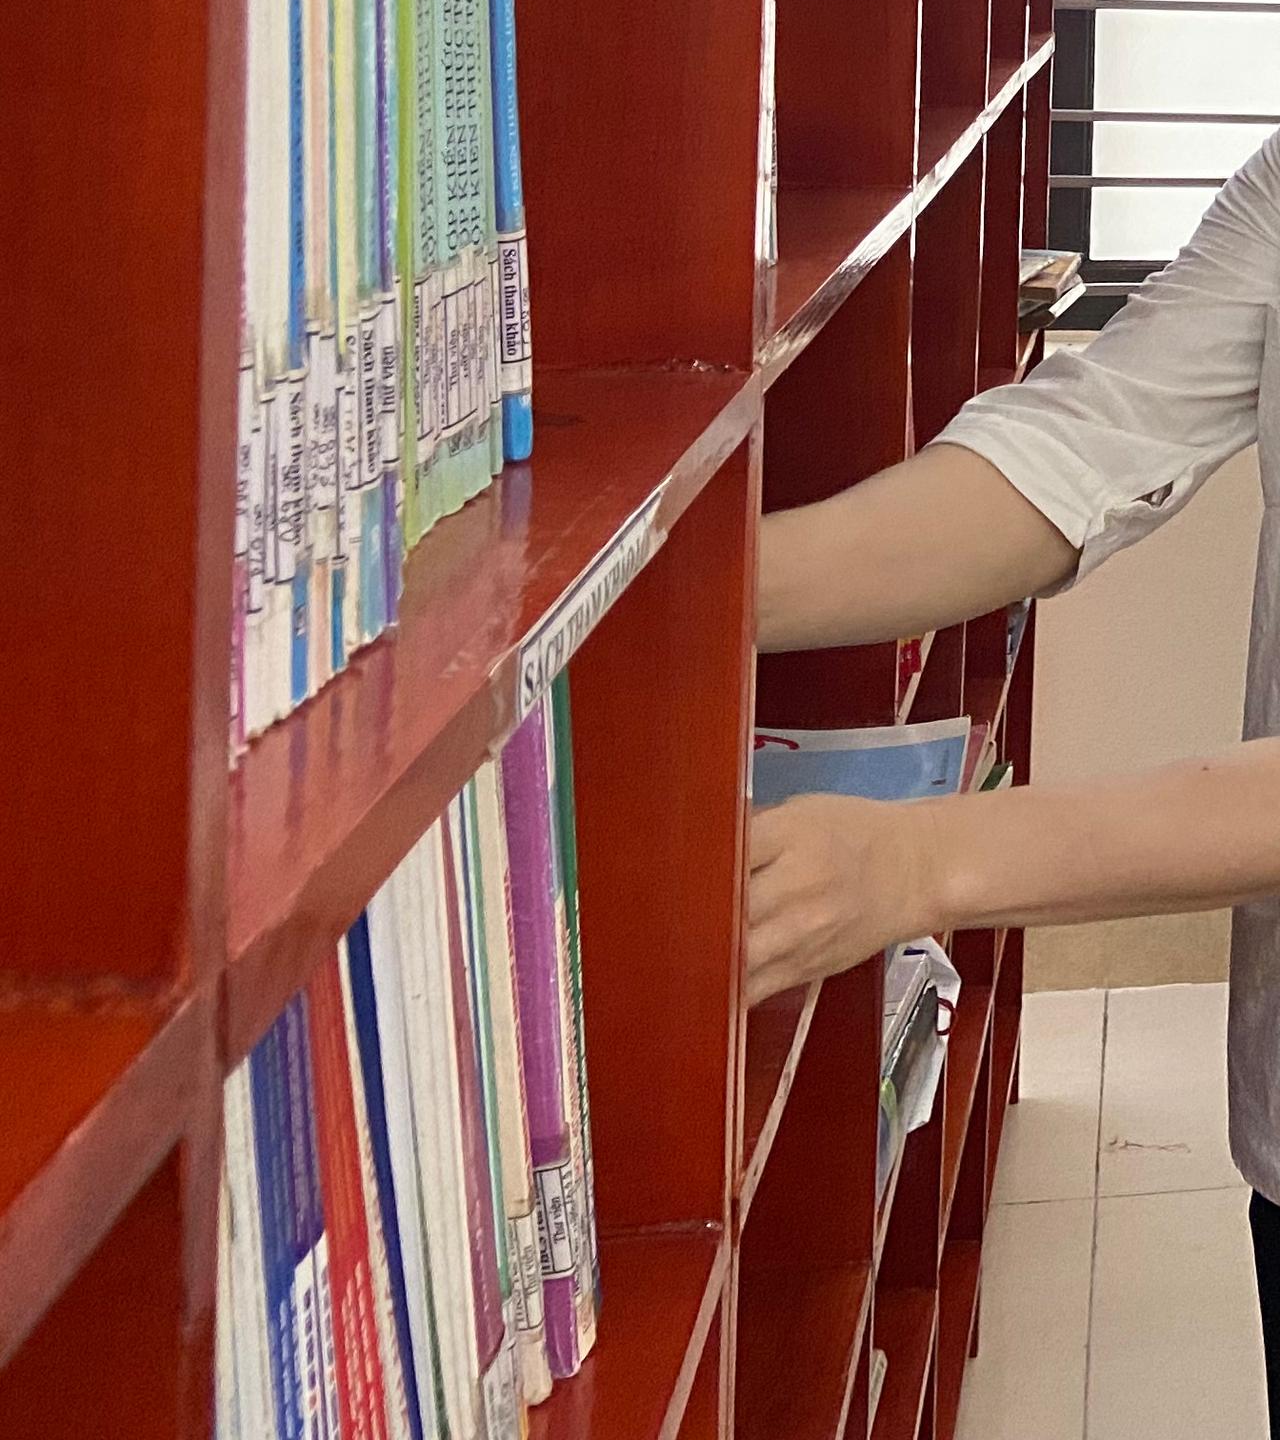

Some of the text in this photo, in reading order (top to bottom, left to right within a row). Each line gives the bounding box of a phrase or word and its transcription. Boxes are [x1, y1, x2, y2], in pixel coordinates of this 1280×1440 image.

[502, 248, 521, 357] Sách tham khảo
